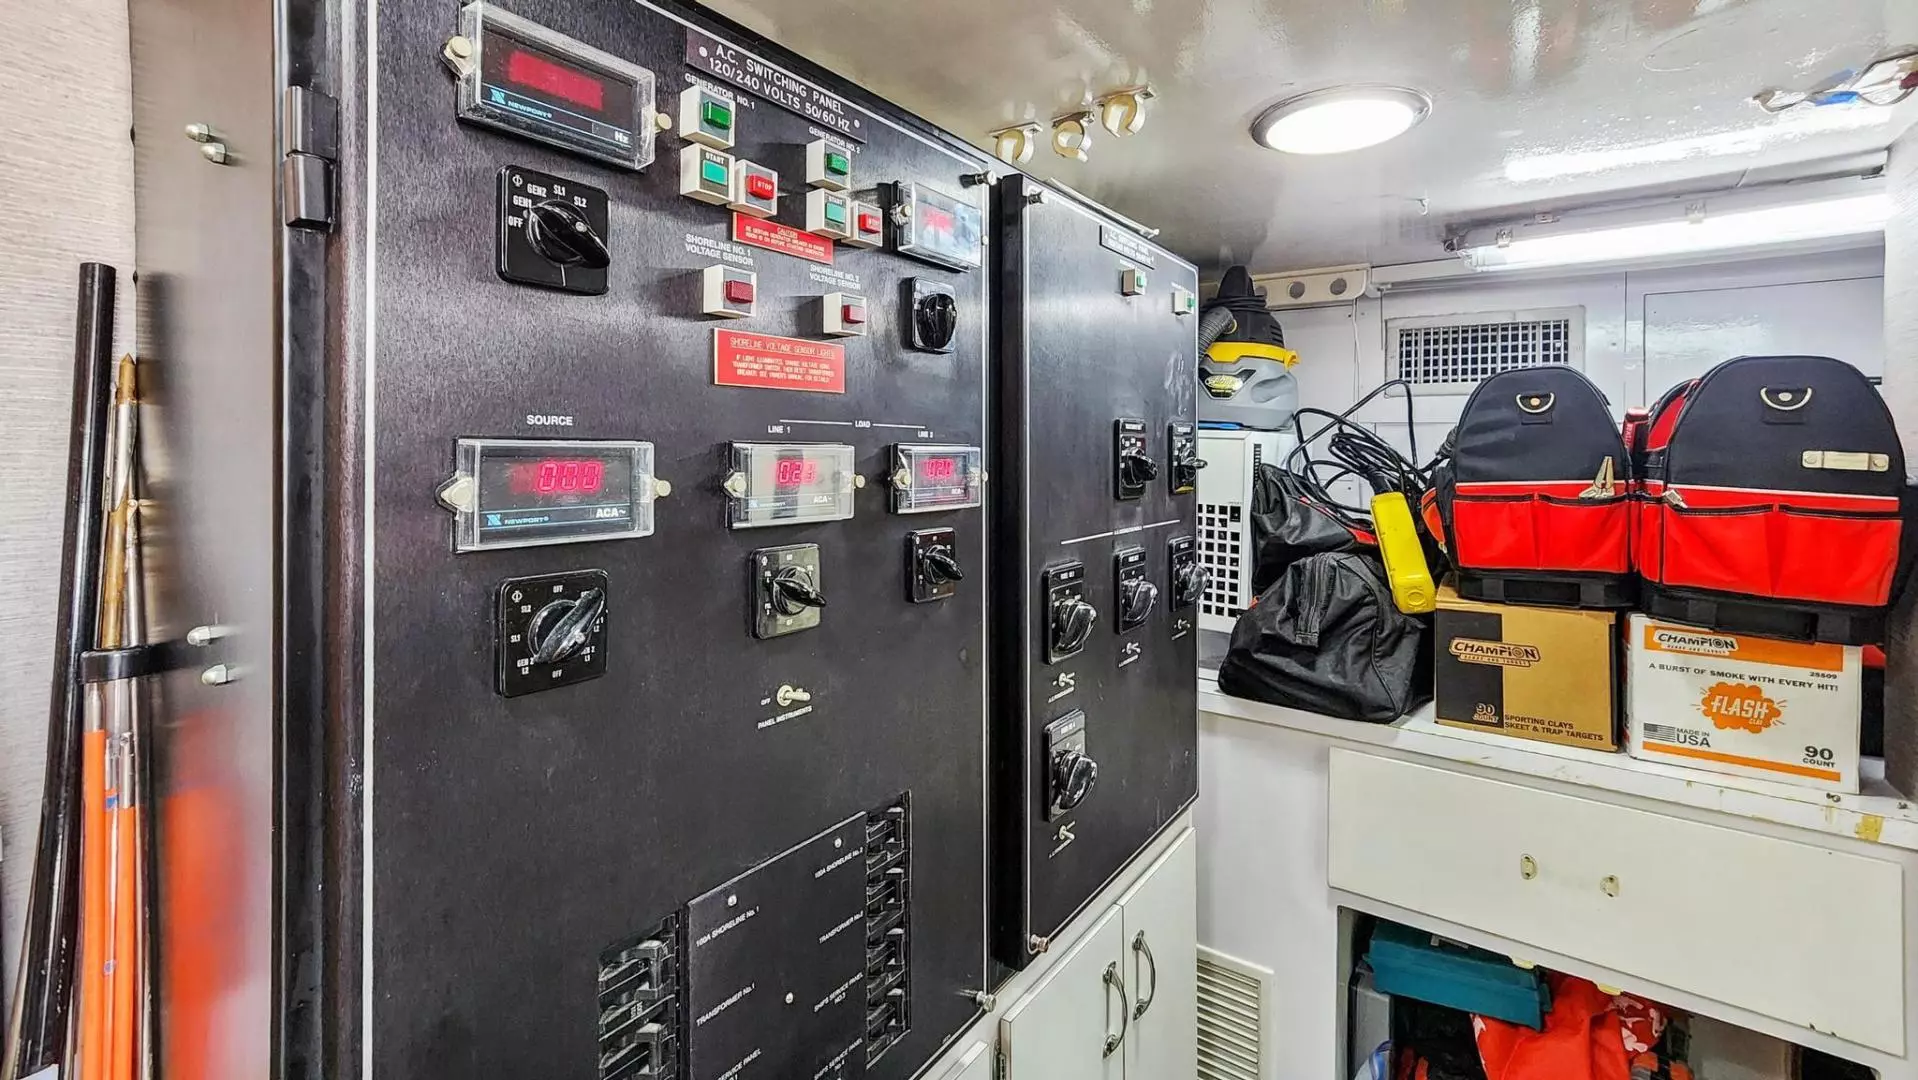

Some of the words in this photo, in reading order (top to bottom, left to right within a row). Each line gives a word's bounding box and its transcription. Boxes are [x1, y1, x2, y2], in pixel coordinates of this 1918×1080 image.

[716, 44, 738, 66] A.C.
[746, 59, 807, 98] SWITCHING
[813, 91, 845, 115] PANEL
[684, 72, 733, 100] GENERATOR
[737, 95, 749, 107] NO.
[750, 101, 755, 110] 1
[709, 57, 760, 90] 120/240
[763, 83, 800, 110] VOLTS
[805, 102, 836, 126] 50/60
[838, 117, 851, 133] HZ
[507, 100, 552, 119] NEWPORT
[614, 130, 629, 144] Hz
[808, 126, 846, 148] GENERATOR
[705, 152, 725, 165] START
[527, 183, 547, 197] GEN2
[553, 184, 566, 196] SL1
[757, 180, 773, 192] STOP
[512, 195, 532, 208] GEN1
[573, 196, 588, 208] SL2
[508, 215, 524, 228] OFF
[685, 233, 732, 250] SHORELINE
[685, 243, 720, 259] VOLTAGE
[722, 251, 754, 266] SENSOR
[810, 264, 845, 279] SHORELINE
[809, 272, 837, 286] VOLTAGE
[838, 278, 861, 290] SENSOR
[730, 337, 762, 349] SHORELINE
[766, 341, 791, 352] VOLTAGE
[794, 345, 815, 356] SENSOR
[526, 414, 573, 426] SOURCE
[855, 420, 871, 428] LOAD
[767, 425, 784, 434] LINE
[787, 426, 791, 434] 1
[504, 516, 549, 525] NEWPORT
[1658, 633, 1736, 649] CHAMPION
[1454, 641, 1537, 659] CHAMPION
[1658, 663, 1691, 673] BURST
[1710, 670, 1745, 680] SMOKE
[1748, 675, 1775, 684] WITH
[1779, 679, 1814, 689] EVERY
[1817, 684, 1839, 692] HIT!
[1475, 702, 1496, 716] 90
[1711, 695, 1769, 719] FLASH
[758, 718, 776, 729] PANEL
[776, 705, 812, 722] INSTRUMENTS
[1504, 714, 1546, 726] SPORTING
[1547, 720, 1574, 730] CLAYS
[1504, 721, 1530, 731] SKEET
[1541, 726, 1564, 736] TRAP
[1566, 730, 1604, 742] TARGETS
[1676, 727, 1700, 736] MADE
[1676, 733, 1711, 748] USA
[1804, 745, 1834, 761] 90
[1802, 757, 1836, 769] COUNT
[826, 852, 852, 872] SHORELINE
[711, 913, 746, 938] SHORELINE
[819, 916, 854, 944] TRANSFORMER
[829, 982, 849, 1001] SERVICE
[849, 971, 864, 985] PANEL
[696, 990, 743, 1027] TRANSFORMER
[743, 1047, 762, 1066] PANEL
[829, 1047, 849, 1069] SERVICE
[849, 1037, 863, 1052] PANEL
